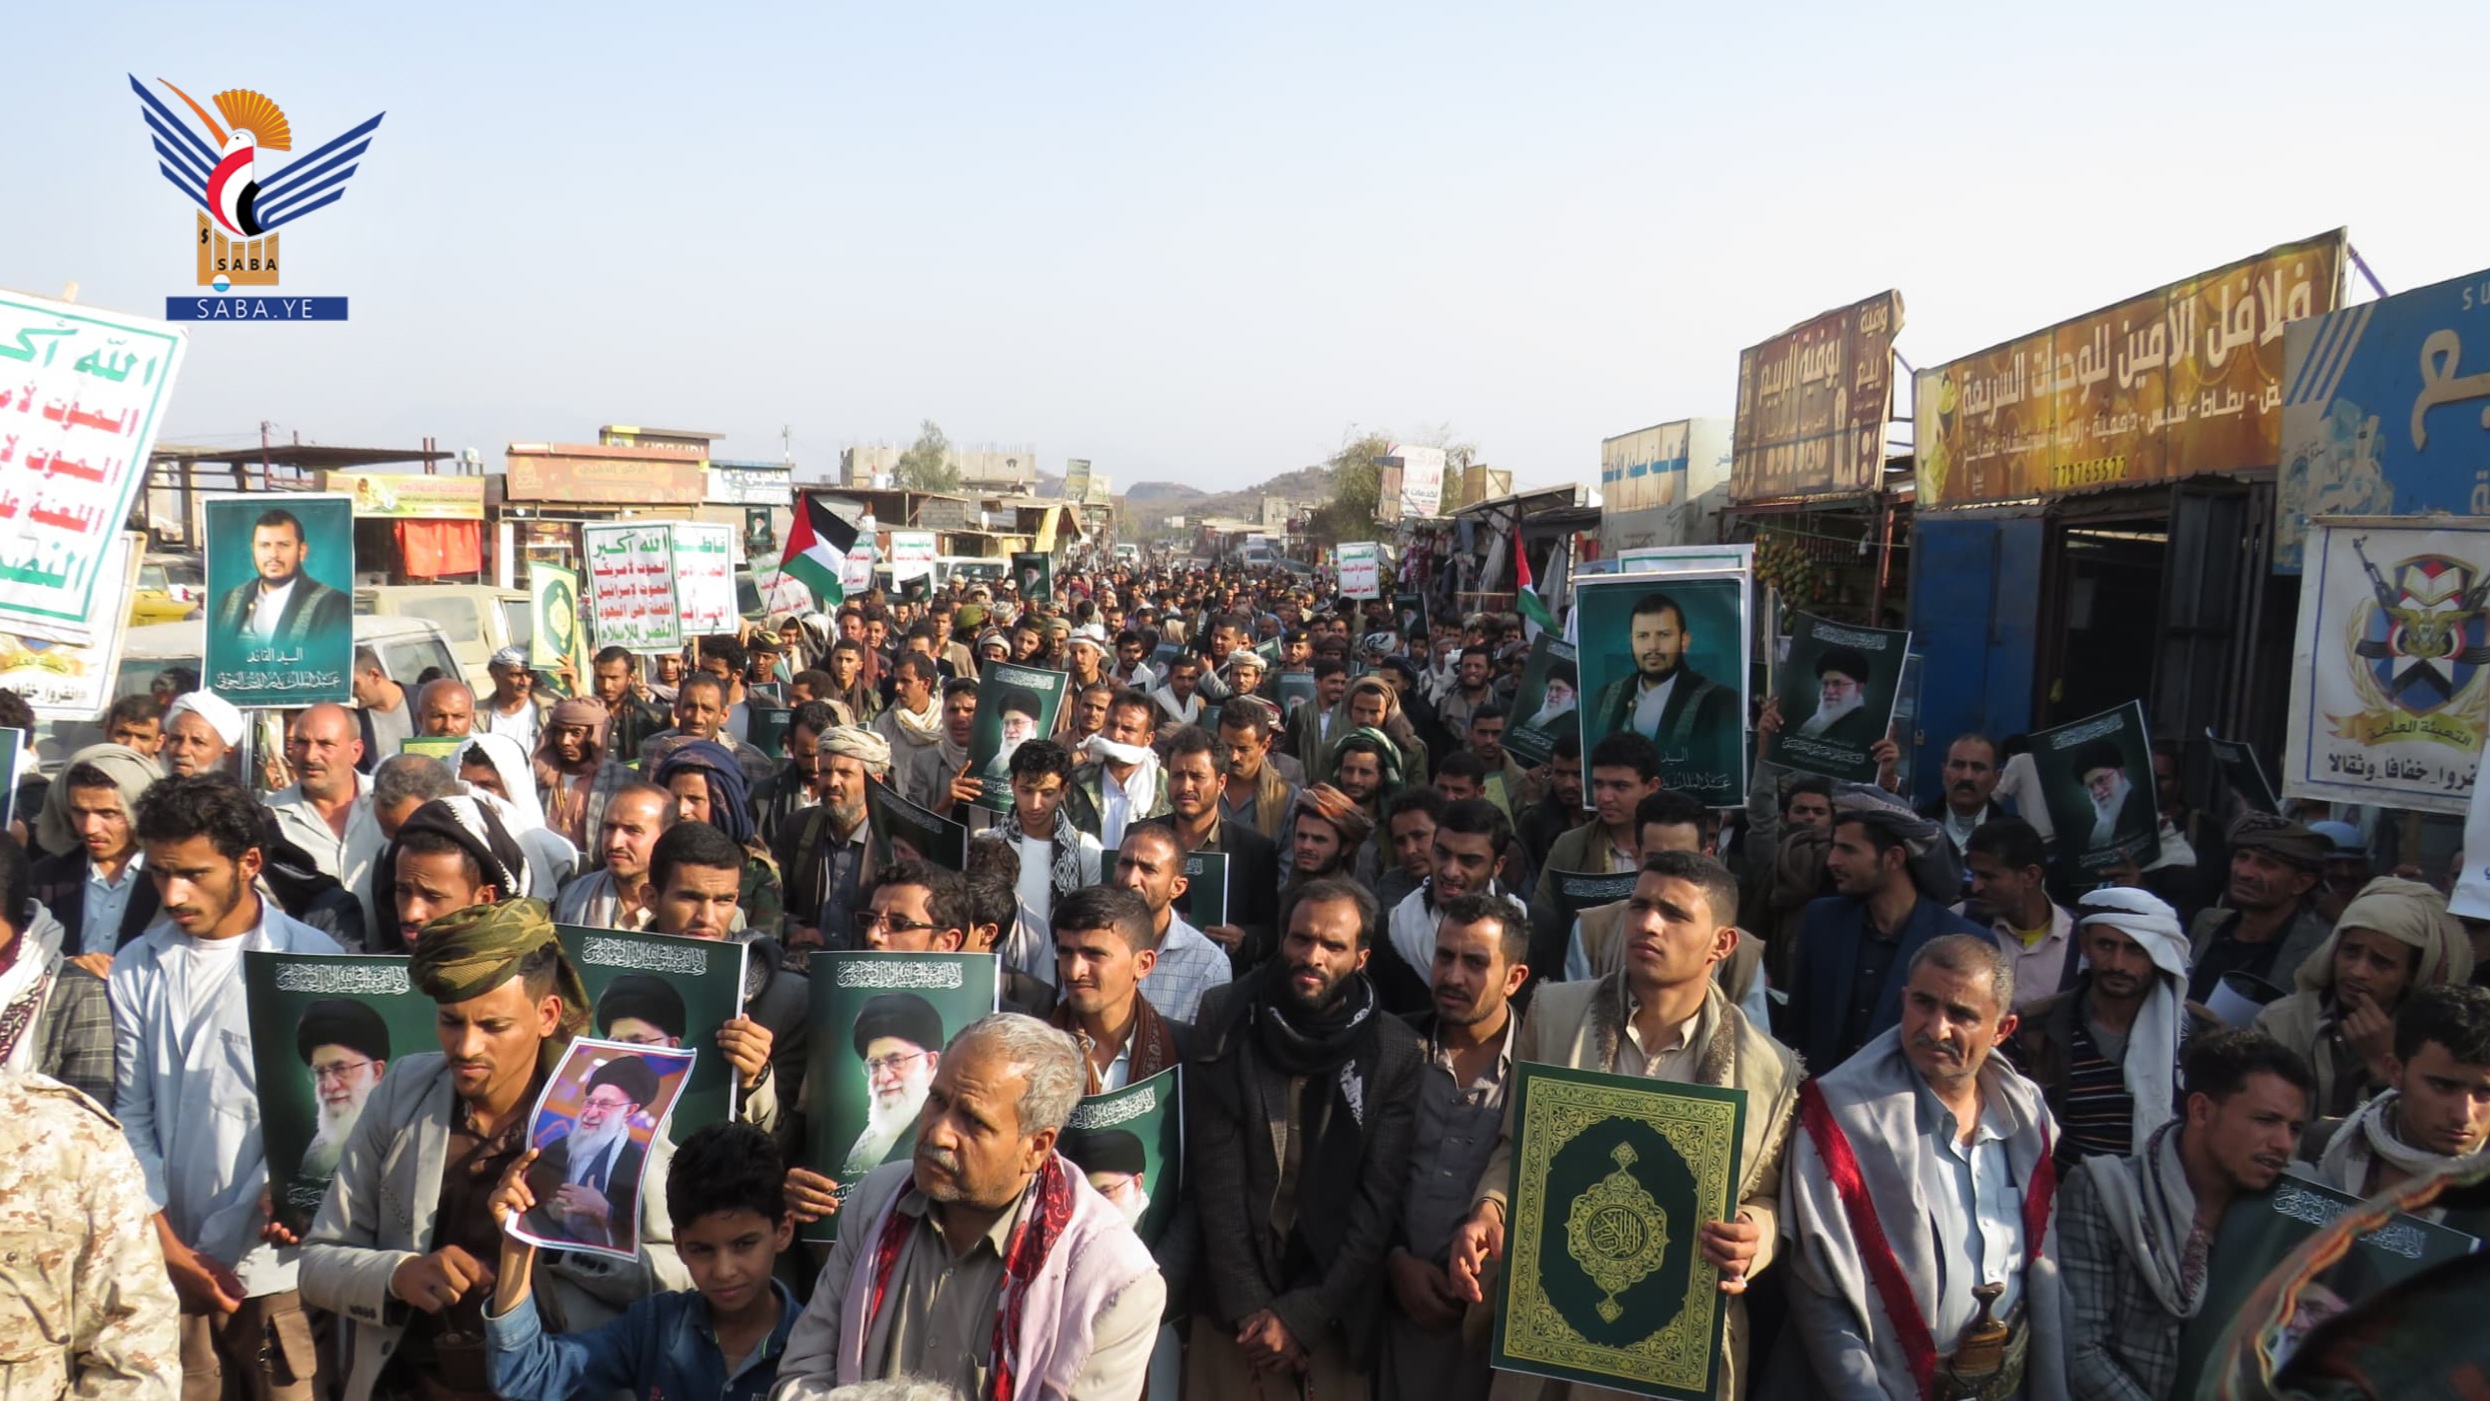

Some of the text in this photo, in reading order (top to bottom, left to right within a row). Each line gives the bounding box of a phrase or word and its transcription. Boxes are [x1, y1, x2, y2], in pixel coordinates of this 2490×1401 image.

[2207, 262, 2313, 369] فلافل
[73, 337, 157, 388] الله
[2031, 323, 2111, 407] للوجبات
[1961, 352, 2026, 428] السريعة
[42, 397, 140, 438] الموت
[25, 447, 122, 486] الموت
[592, 528, 668, 561] الله أكبر
[0, 541, 88, 592] النص
[637, 560, 669, 578] الموت
[639, 581, 672, 598] الموت
[644, 620, 676, 643] النصر
